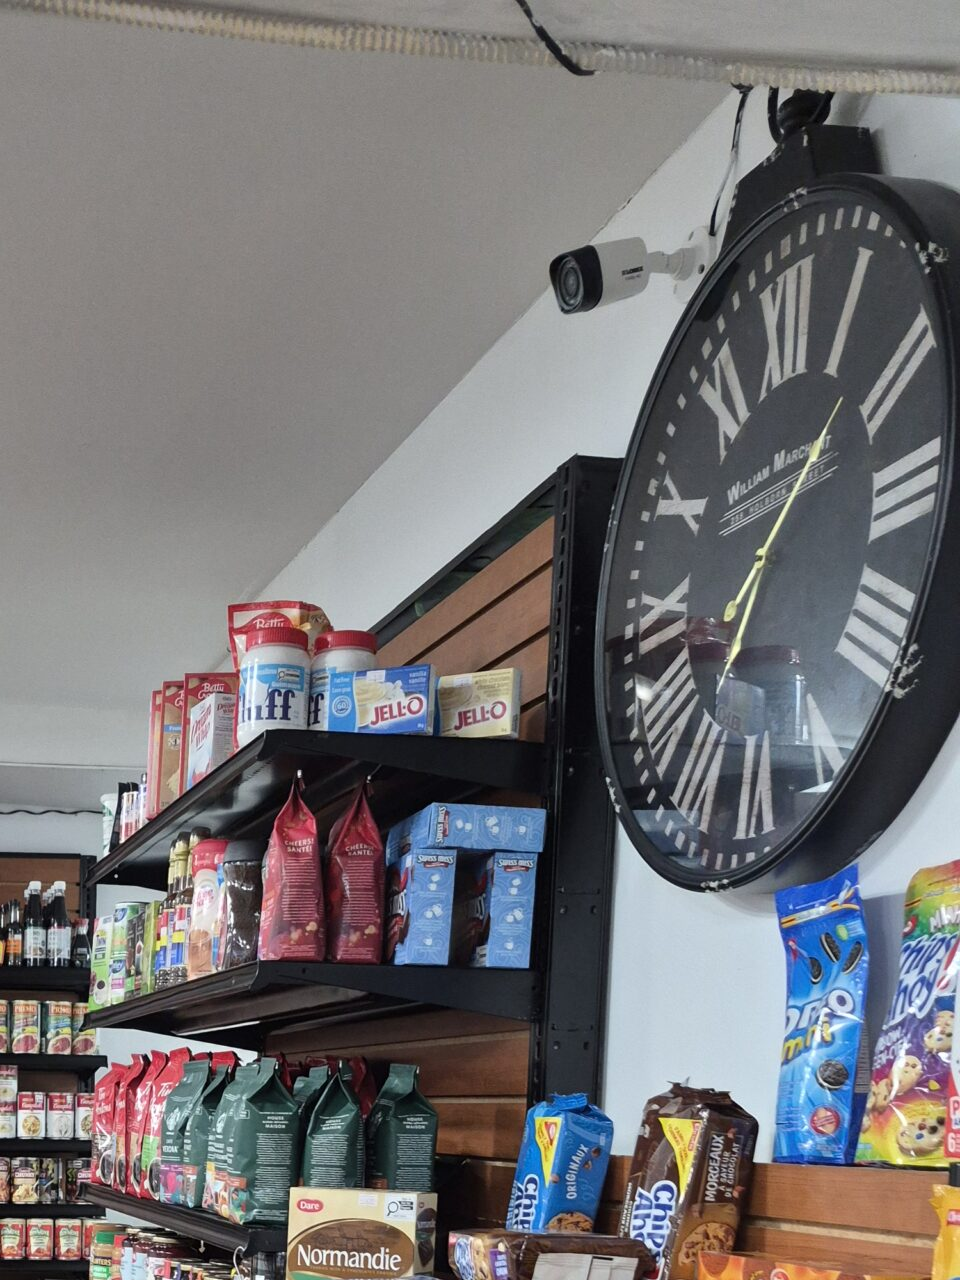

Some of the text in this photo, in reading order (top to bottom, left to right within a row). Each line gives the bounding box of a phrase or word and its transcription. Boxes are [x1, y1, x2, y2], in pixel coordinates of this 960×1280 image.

[759, 254, 815, 402] XII
[698, 338, 752, 463] XI
[859, 303, 937, 443] II
[727, 435, 832, 506] WILLIAM MARCHT
[869, 436, 940, 543] III
[655, 472, 708, 536] X
[240, 688, 296, 724] luff
[284, 838, 315, 847] CHEERS!
[14, 1005, 36, 1013] PRIMO
[565, 1144, 589, 1200] ORIGINAUX
[704, 1133, 726, 1202] MORCEAUX
[300, 1201, 321, 1211] Dare
[296, 1244, 402, 1272] Normandie
